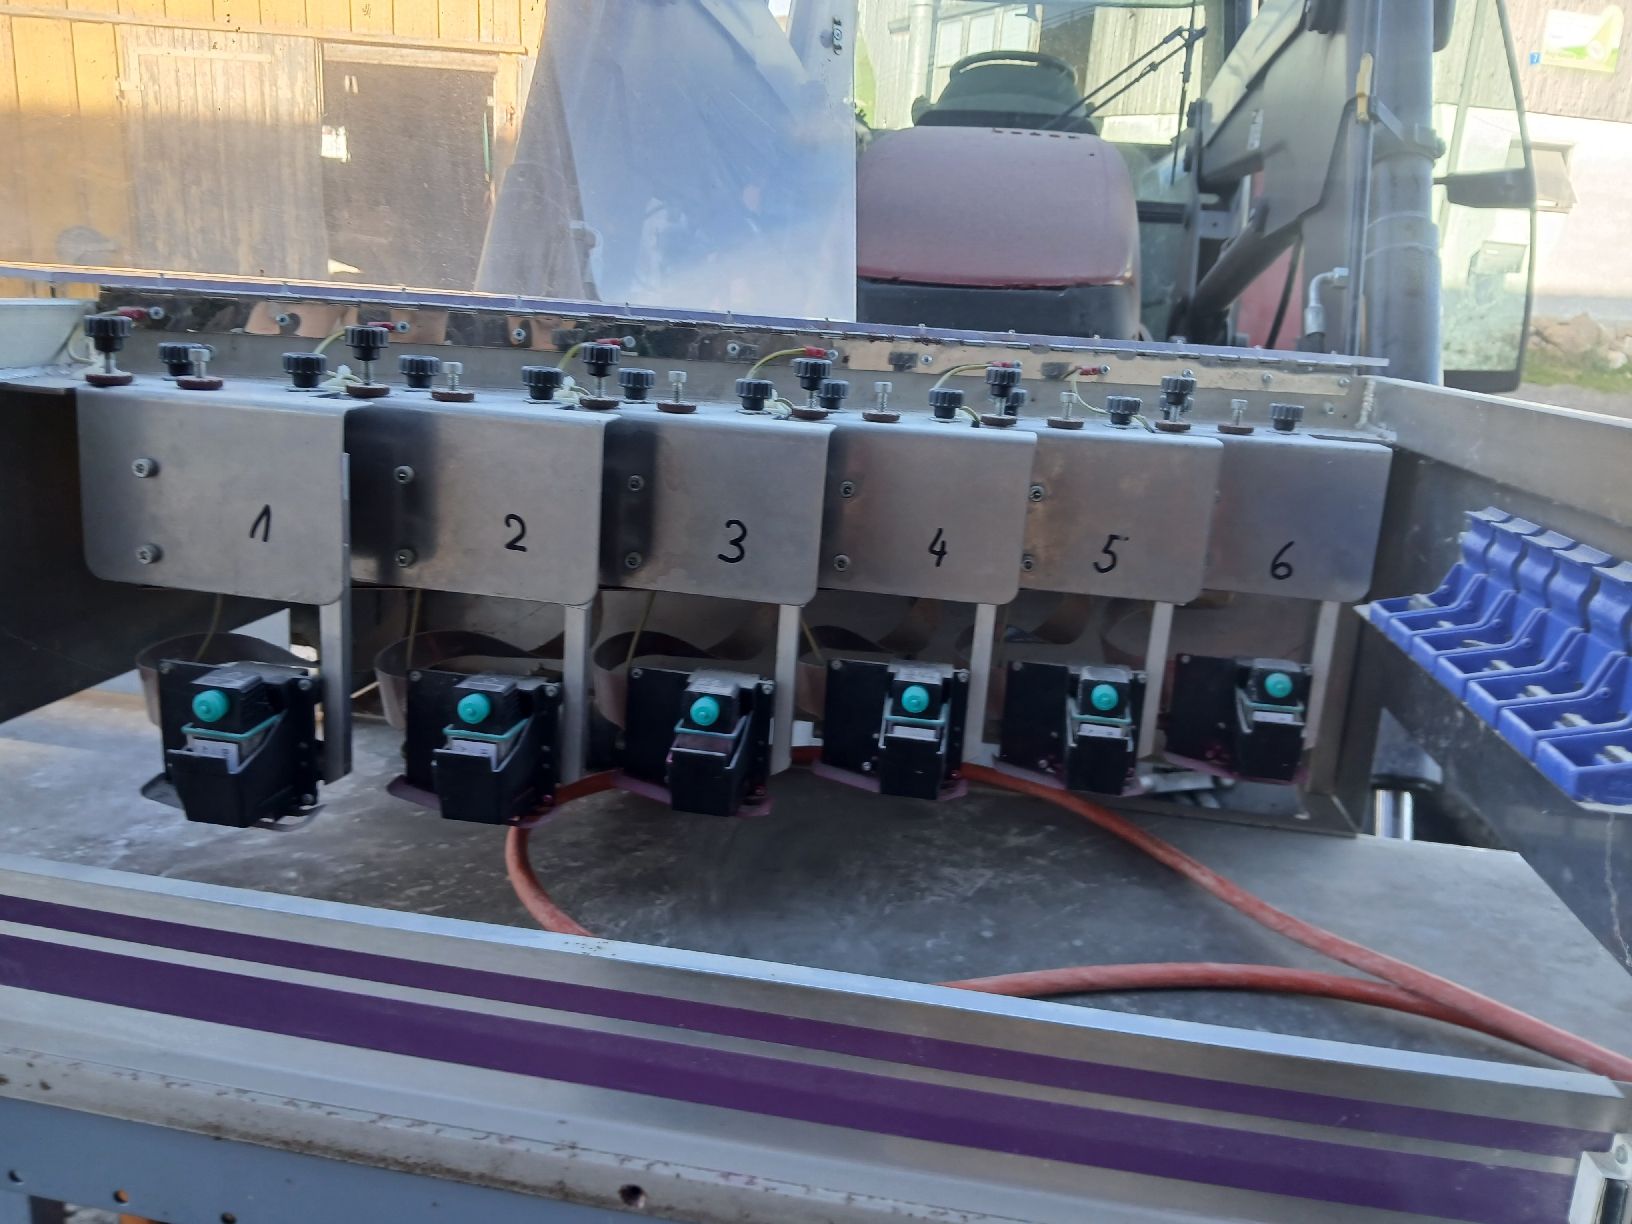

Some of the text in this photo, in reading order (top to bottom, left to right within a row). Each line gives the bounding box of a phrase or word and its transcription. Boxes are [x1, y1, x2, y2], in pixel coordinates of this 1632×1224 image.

[249, 504, 271, 542] 1
[504, 513, 528, 552] 2
[717, 519, 748, 564] 3
[928, 528, 948, 567] 4
[1093, 534, 1129, 573] 5
[1270, 541, 1295, 581] 6
